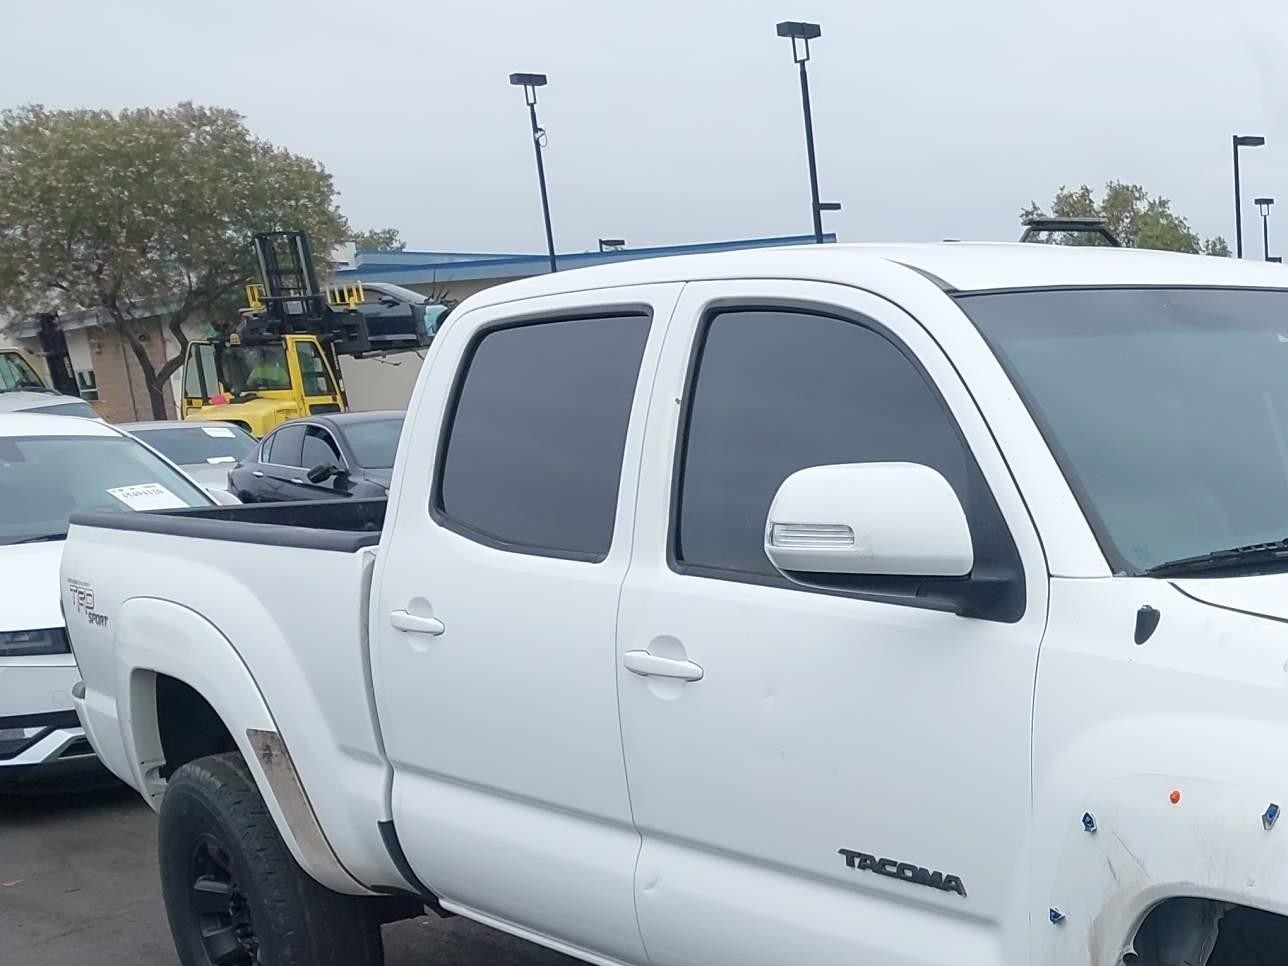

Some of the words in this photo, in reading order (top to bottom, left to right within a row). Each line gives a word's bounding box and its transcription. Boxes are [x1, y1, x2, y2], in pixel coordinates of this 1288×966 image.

[69, 584, 95, 613] TRD
[88, 612, 109, 627] SPORT
[837, 848, 968, 898] TACOMA
